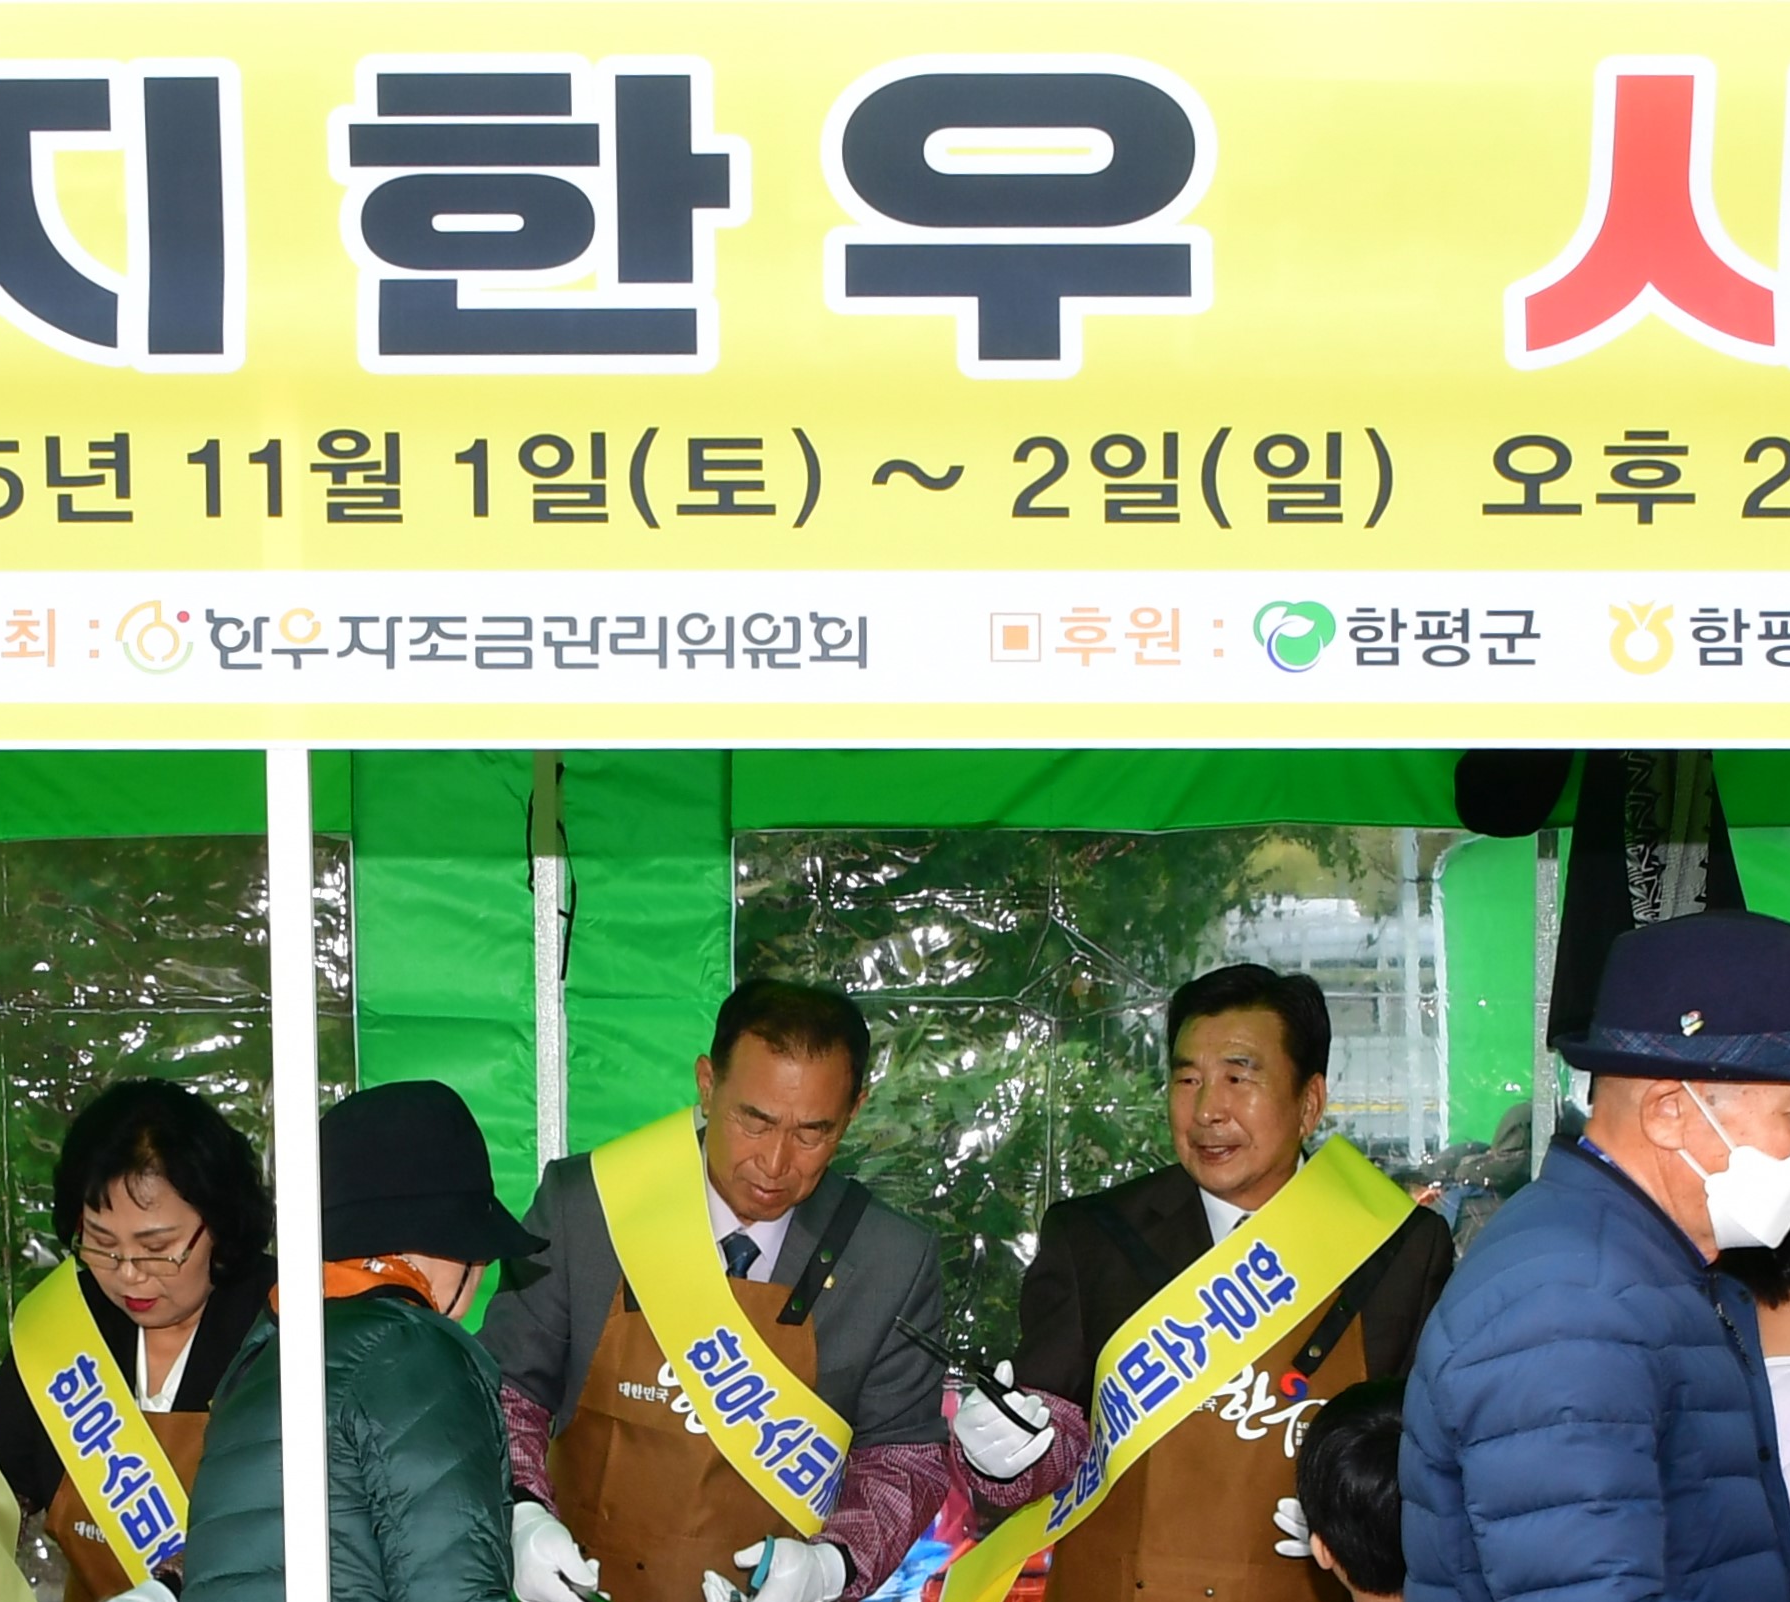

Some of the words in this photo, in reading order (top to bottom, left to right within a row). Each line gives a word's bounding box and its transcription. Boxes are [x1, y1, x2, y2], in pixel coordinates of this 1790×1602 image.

[187, 429, 403, 523] 11월
[455, 427, 821, 529] 1일(토)
[1012, 427, 1393, 529] 2일(일)
[1482, 430, 1696, 524] 오후
[205, 605, 868, 670] 한우자조금관리위원회
[1055, 607, 1181, 667] 후원
[1346, 607, 1541, 667] 함평군
